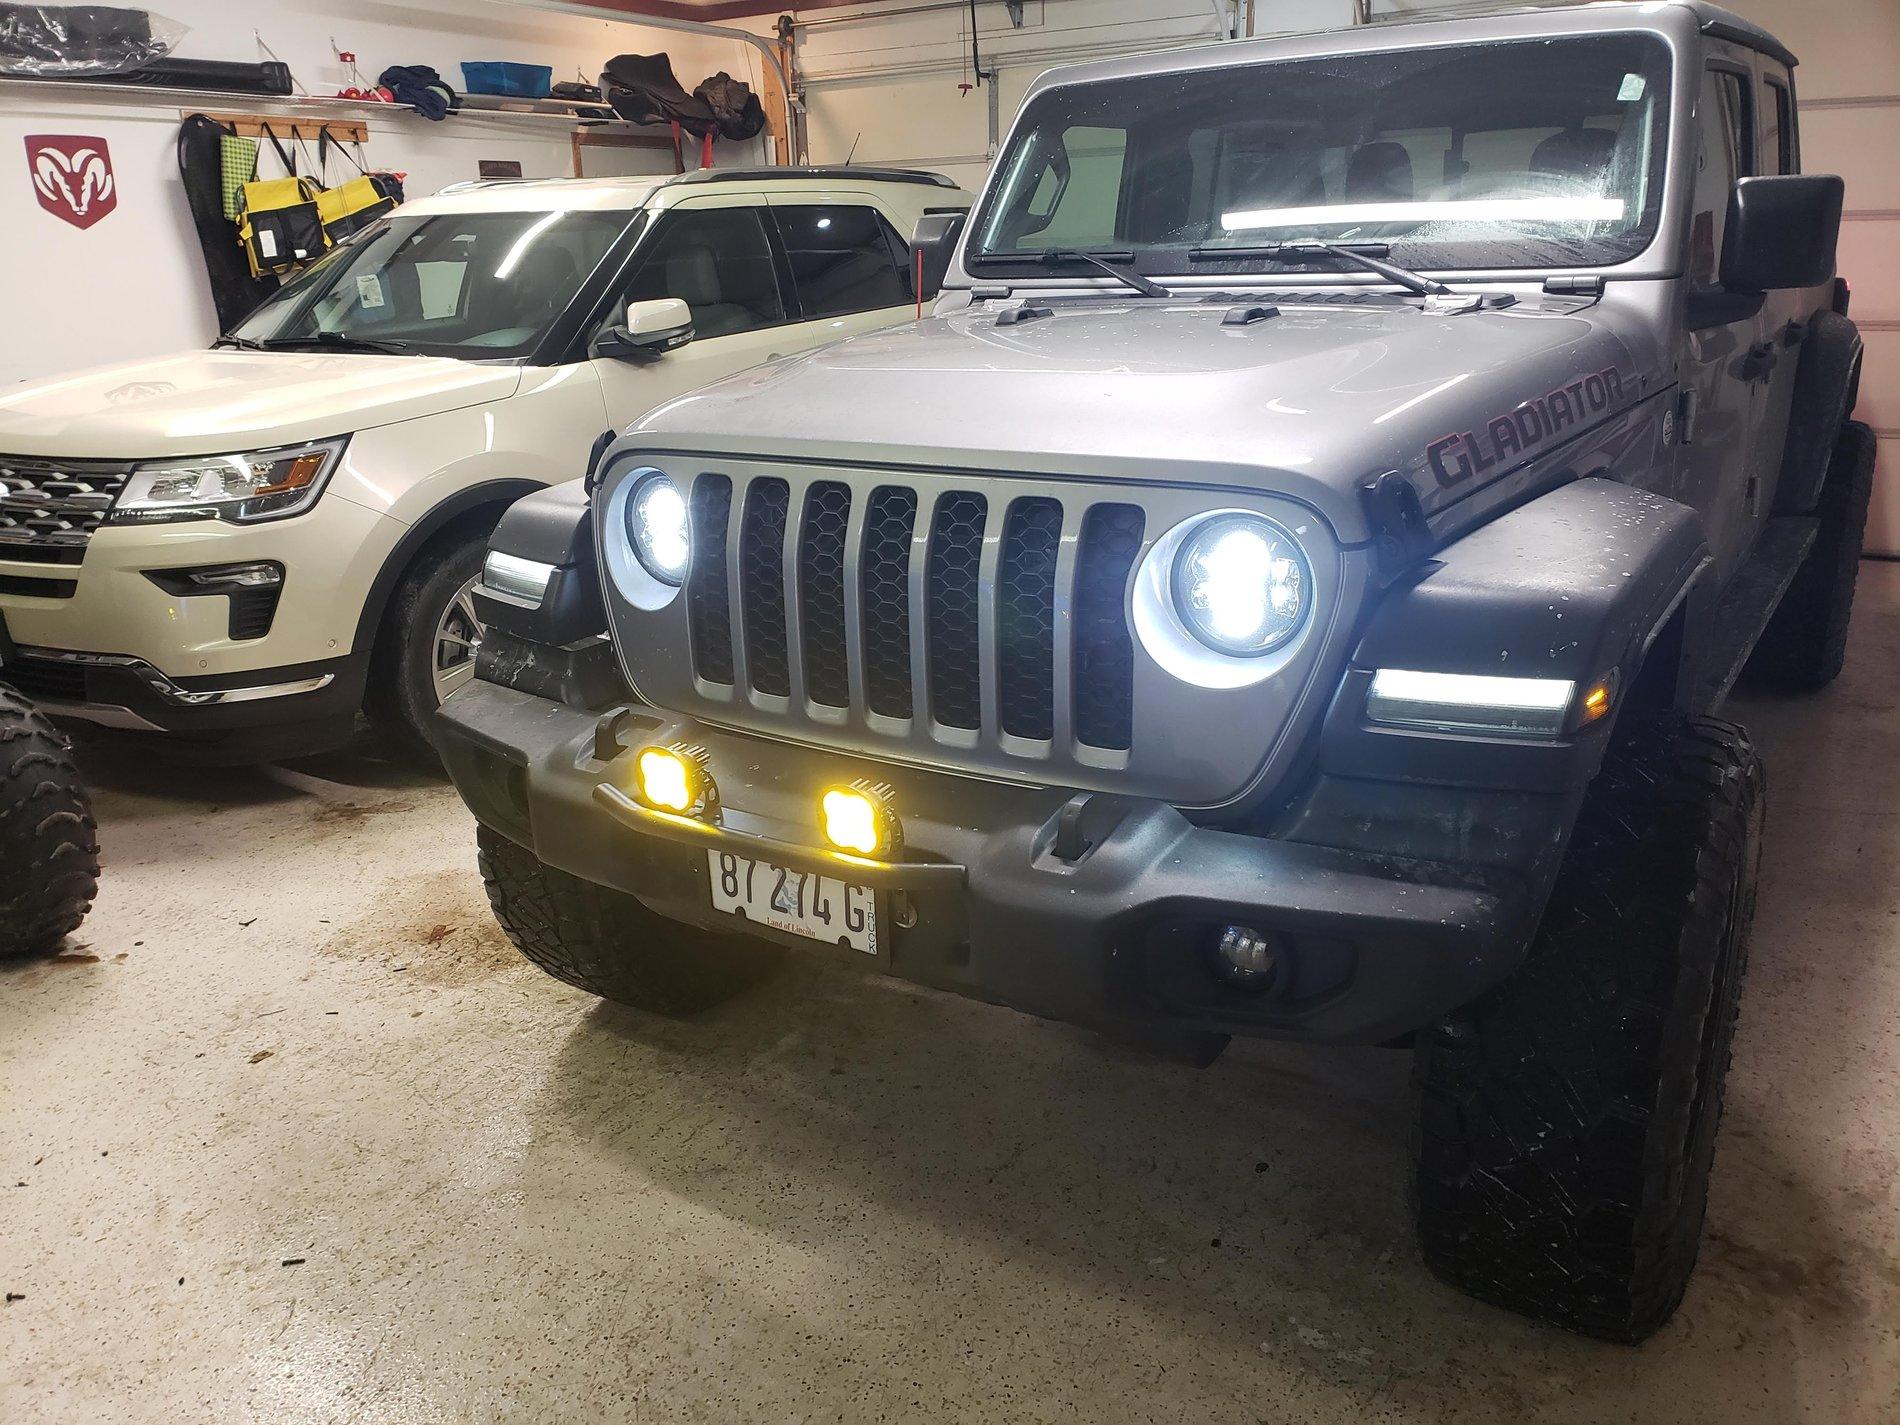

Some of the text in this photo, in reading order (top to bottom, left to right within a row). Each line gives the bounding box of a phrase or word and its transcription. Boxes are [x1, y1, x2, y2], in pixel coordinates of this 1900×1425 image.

[1426, 365, 1625, 490] GLADIATOR
[766, 916, 817, 937] Land of Lincoln
[844, 882, 865, 933] G
[866, 901, 877, 954] TRUCK
